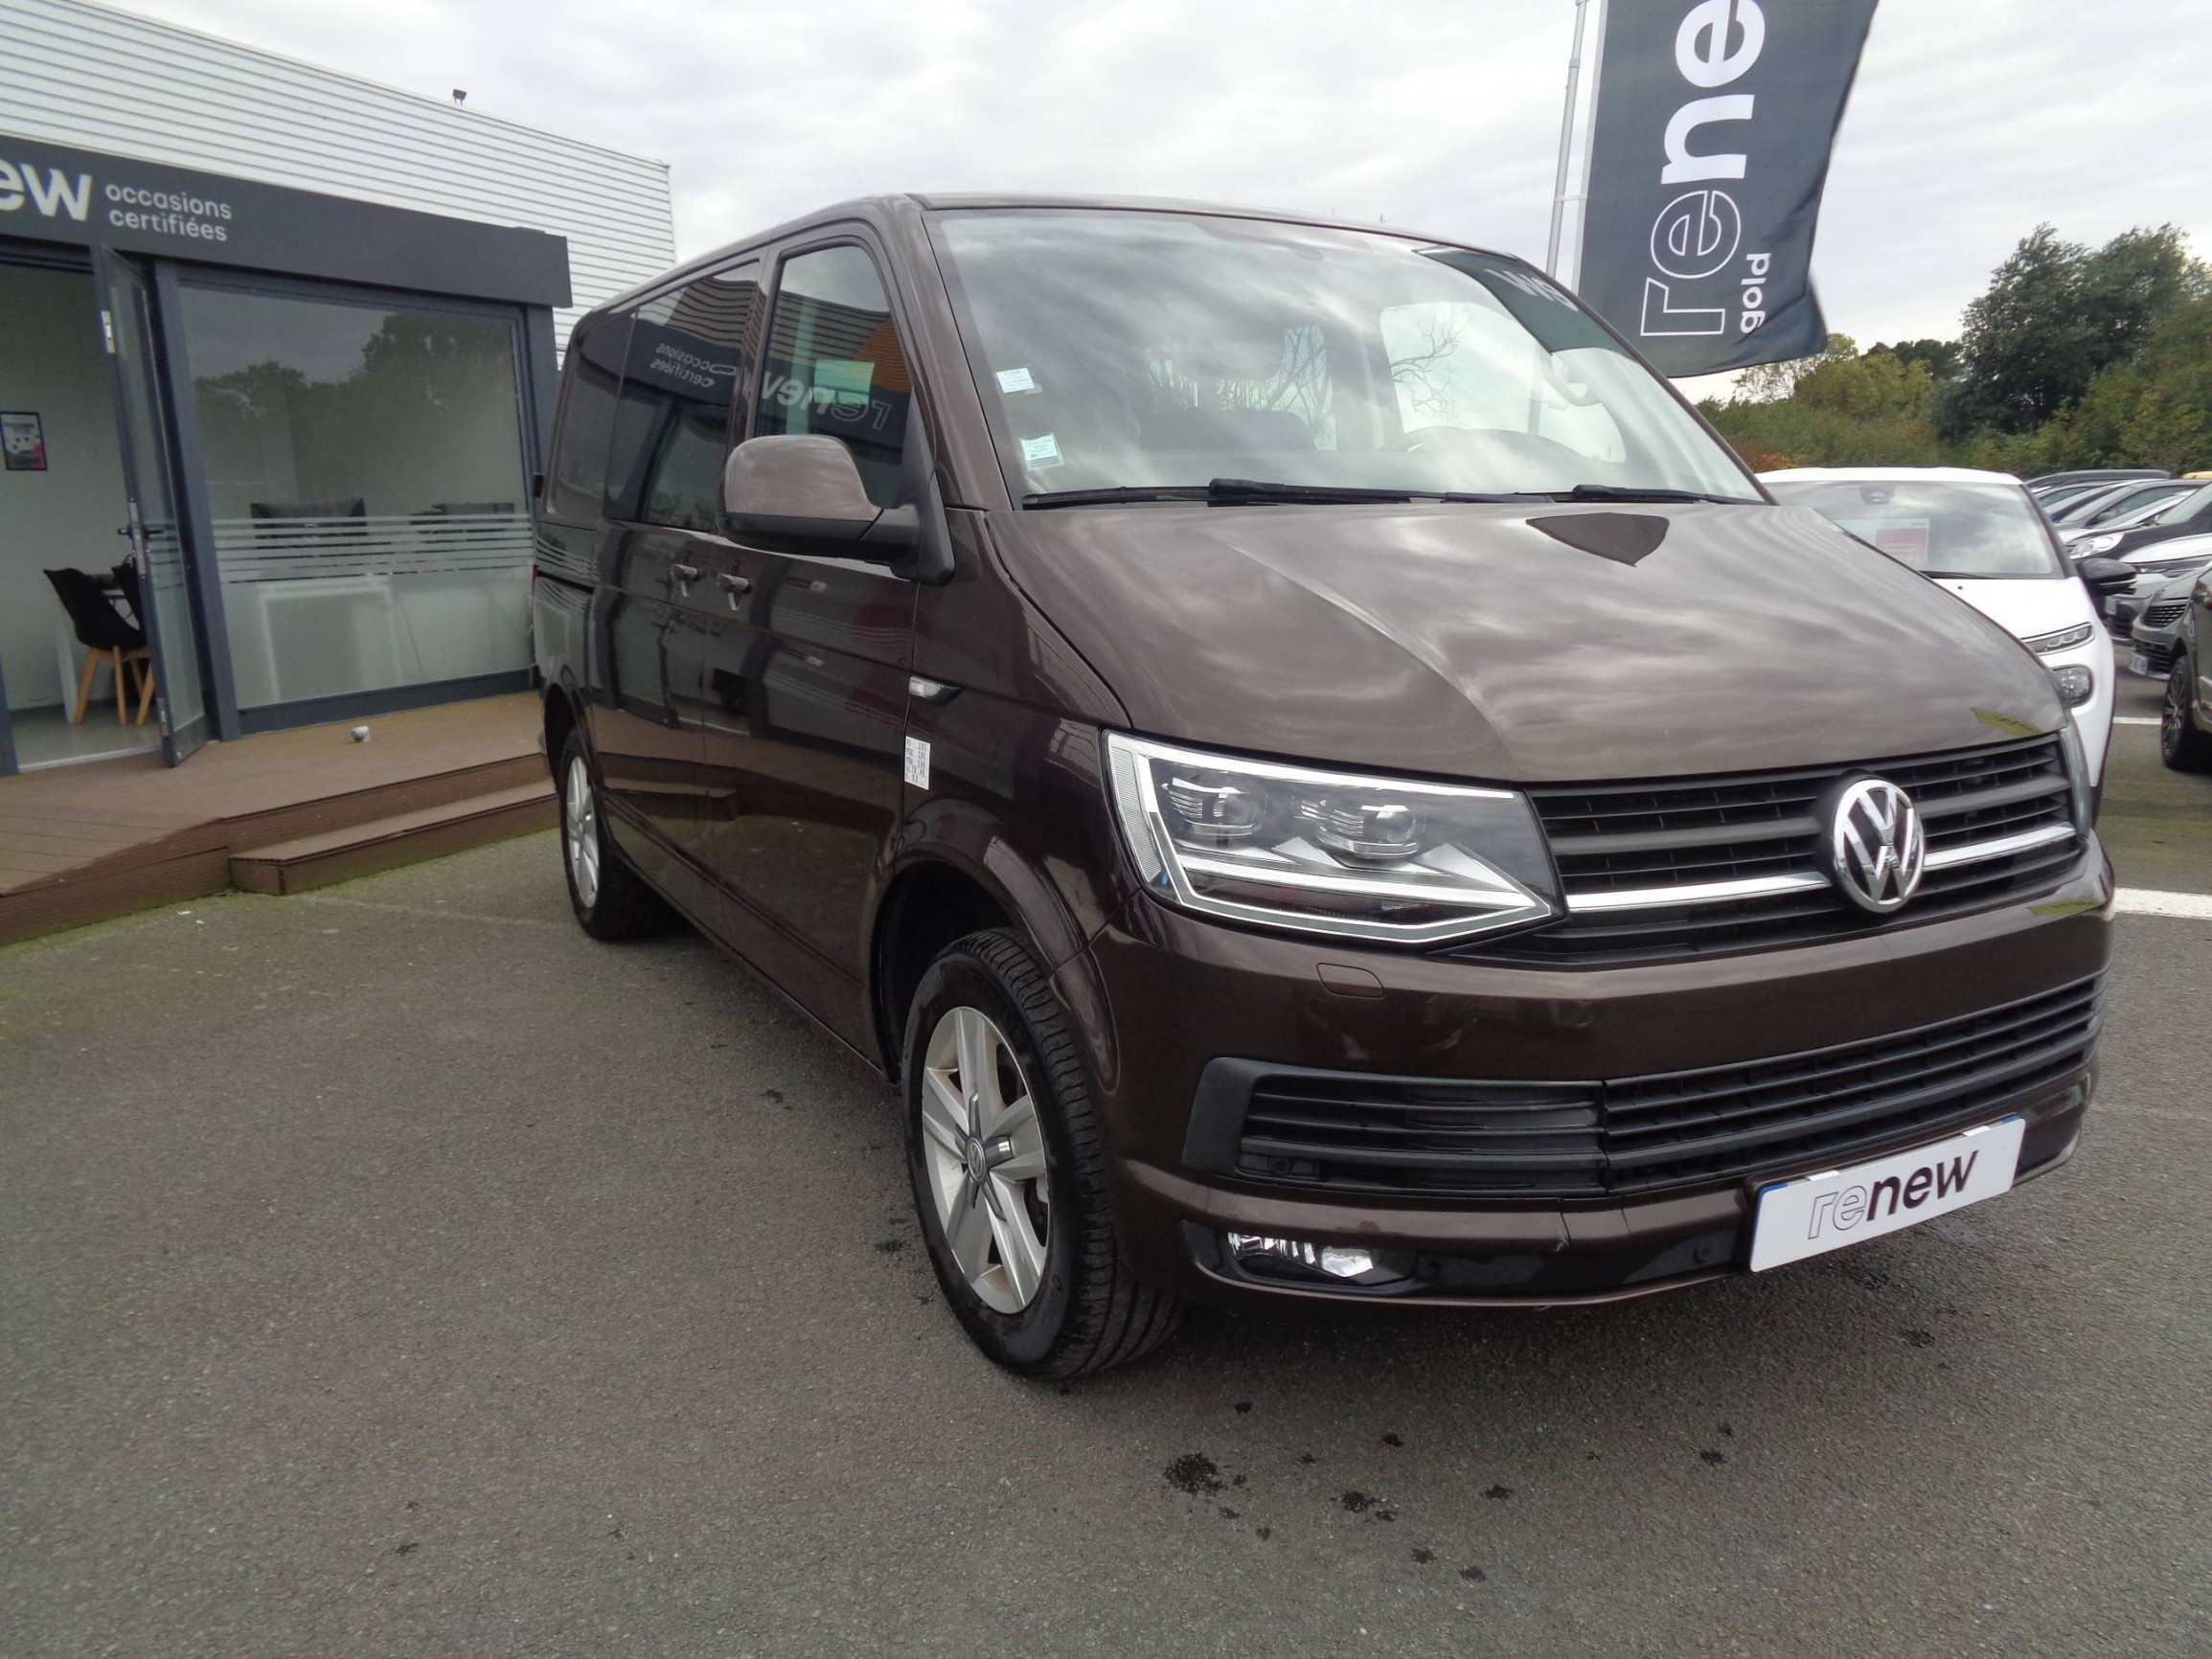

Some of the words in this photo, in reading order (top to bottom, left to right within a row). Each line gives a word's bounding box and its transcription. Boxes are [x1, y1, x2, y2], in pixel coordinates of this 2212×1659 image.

[104, 183, 233, 220] occasions
[109, 209, 228, 241] certifiées
[1740, 252, 1771, 334] gold
[1808, 1149, 1979, 1239] renew
